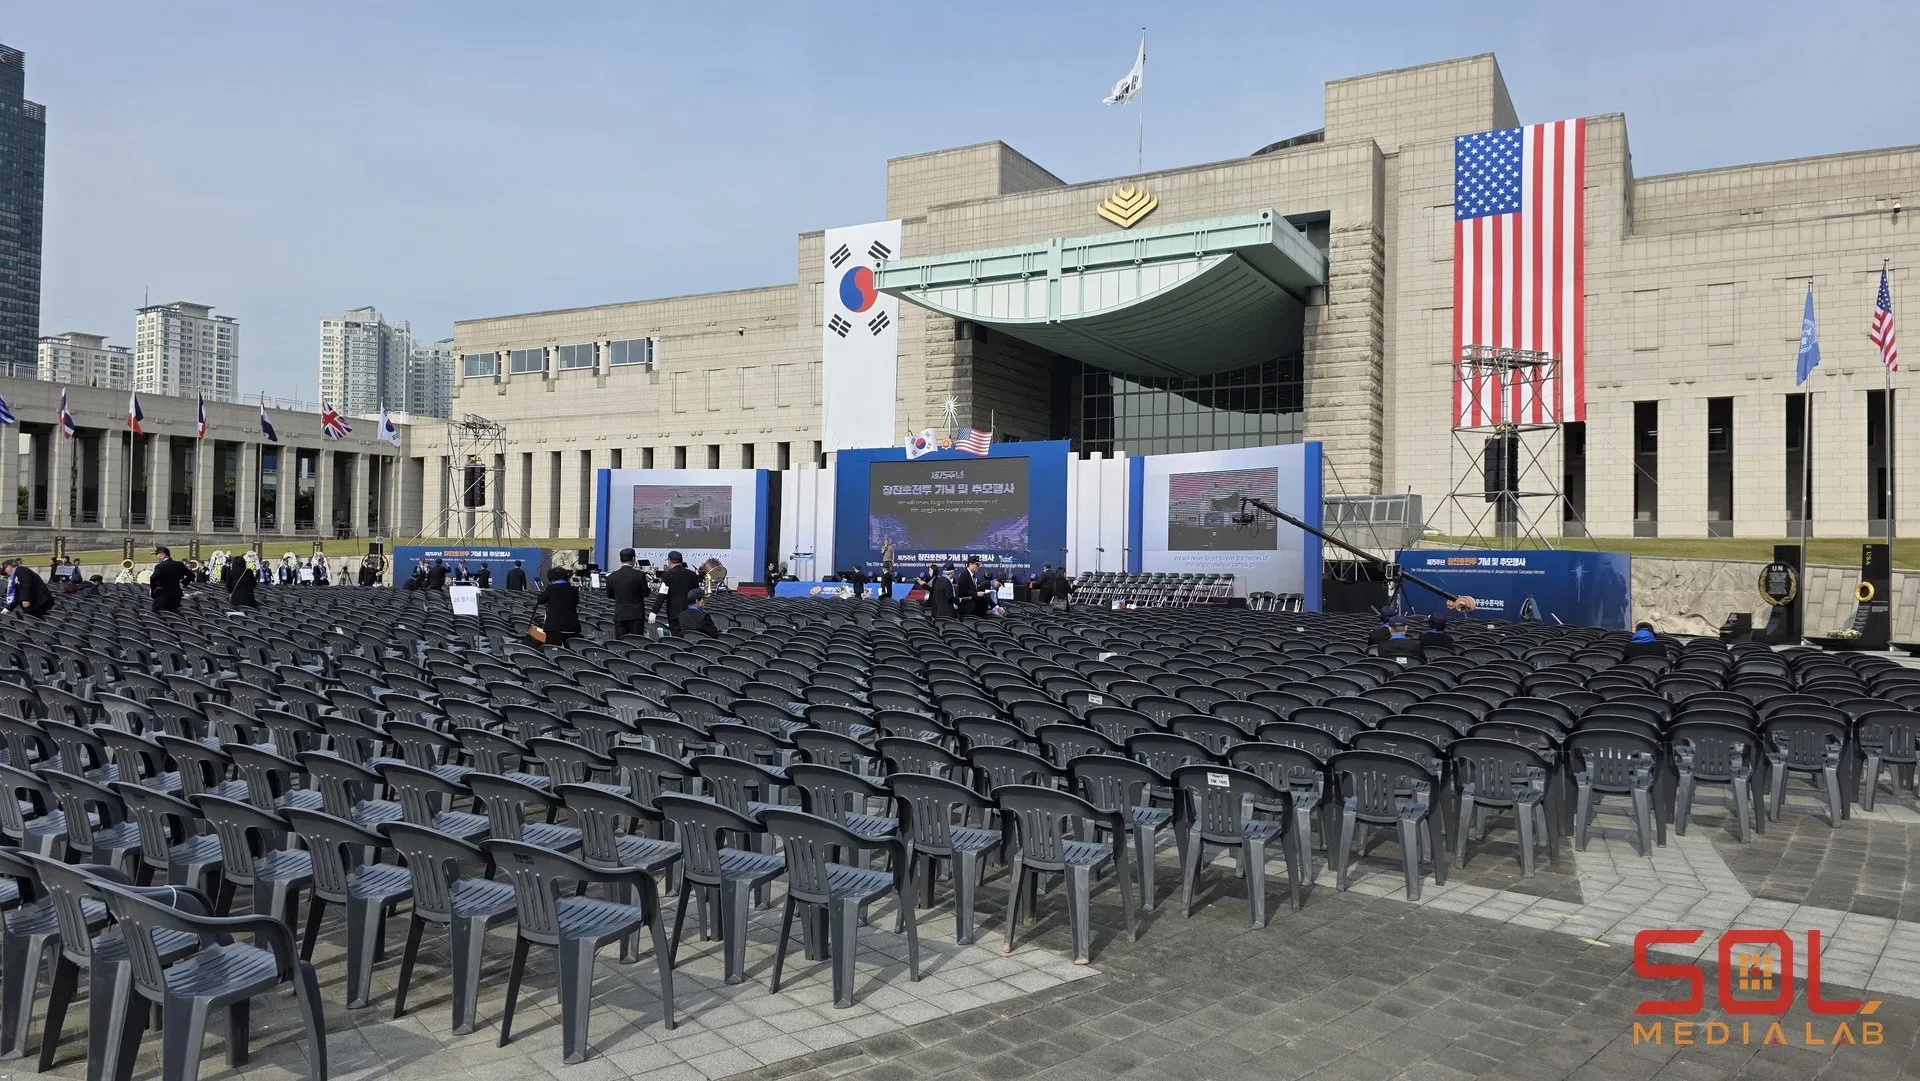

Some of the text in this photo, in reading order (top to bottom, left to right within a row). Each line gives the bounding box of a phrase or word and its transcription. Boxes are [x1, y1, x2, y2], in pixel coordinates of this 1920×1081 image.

[931, 470, 964, 479] 제75주년
[882, 484, 932, 496] 장진호전투
[934, 484, 955, 495] 기념
[971, 482, 1016, 494] 추모행사
[917, 553, 947, 562] 장진호전투
[948, 553, 961, 562] 기념
[961, 553, 969, 562] 및
[1477, 557, 1491, 566] 기념
[1491, 557, 1499, 566] 및
[1499, 557, 1527, 567] 추모행사
